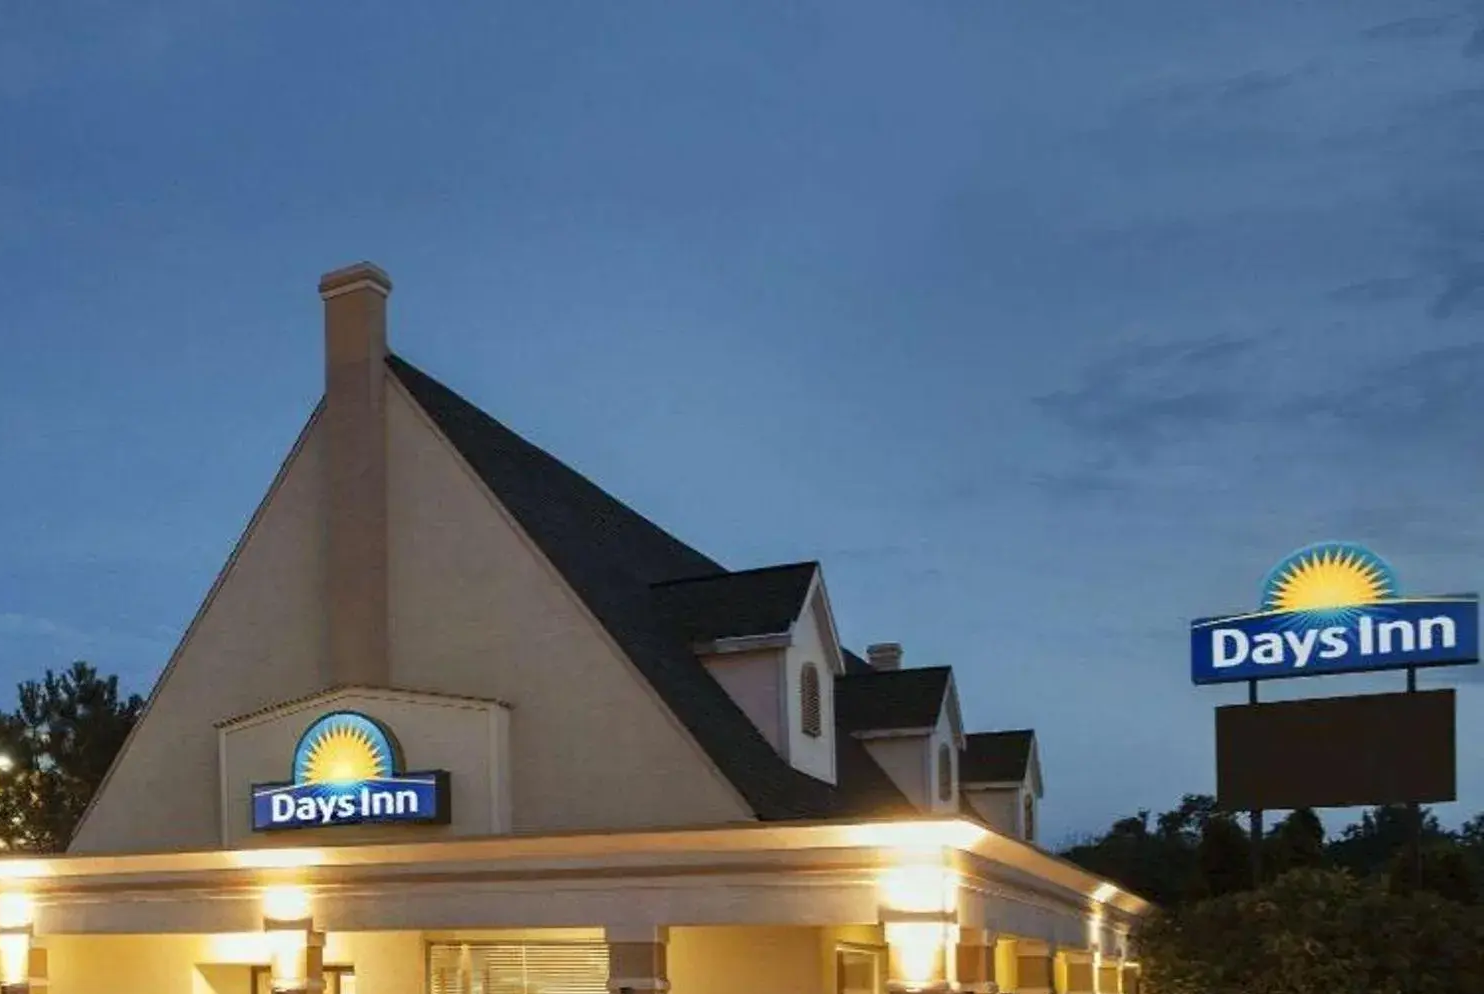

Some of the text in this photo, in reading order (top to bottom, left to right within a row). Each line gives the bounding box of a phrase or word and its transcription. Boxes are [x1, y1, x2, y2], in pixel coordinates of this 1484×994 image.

[1212, 616, 1456, 668] Days Inn
[271, 787, 419, 824] Days Inn
